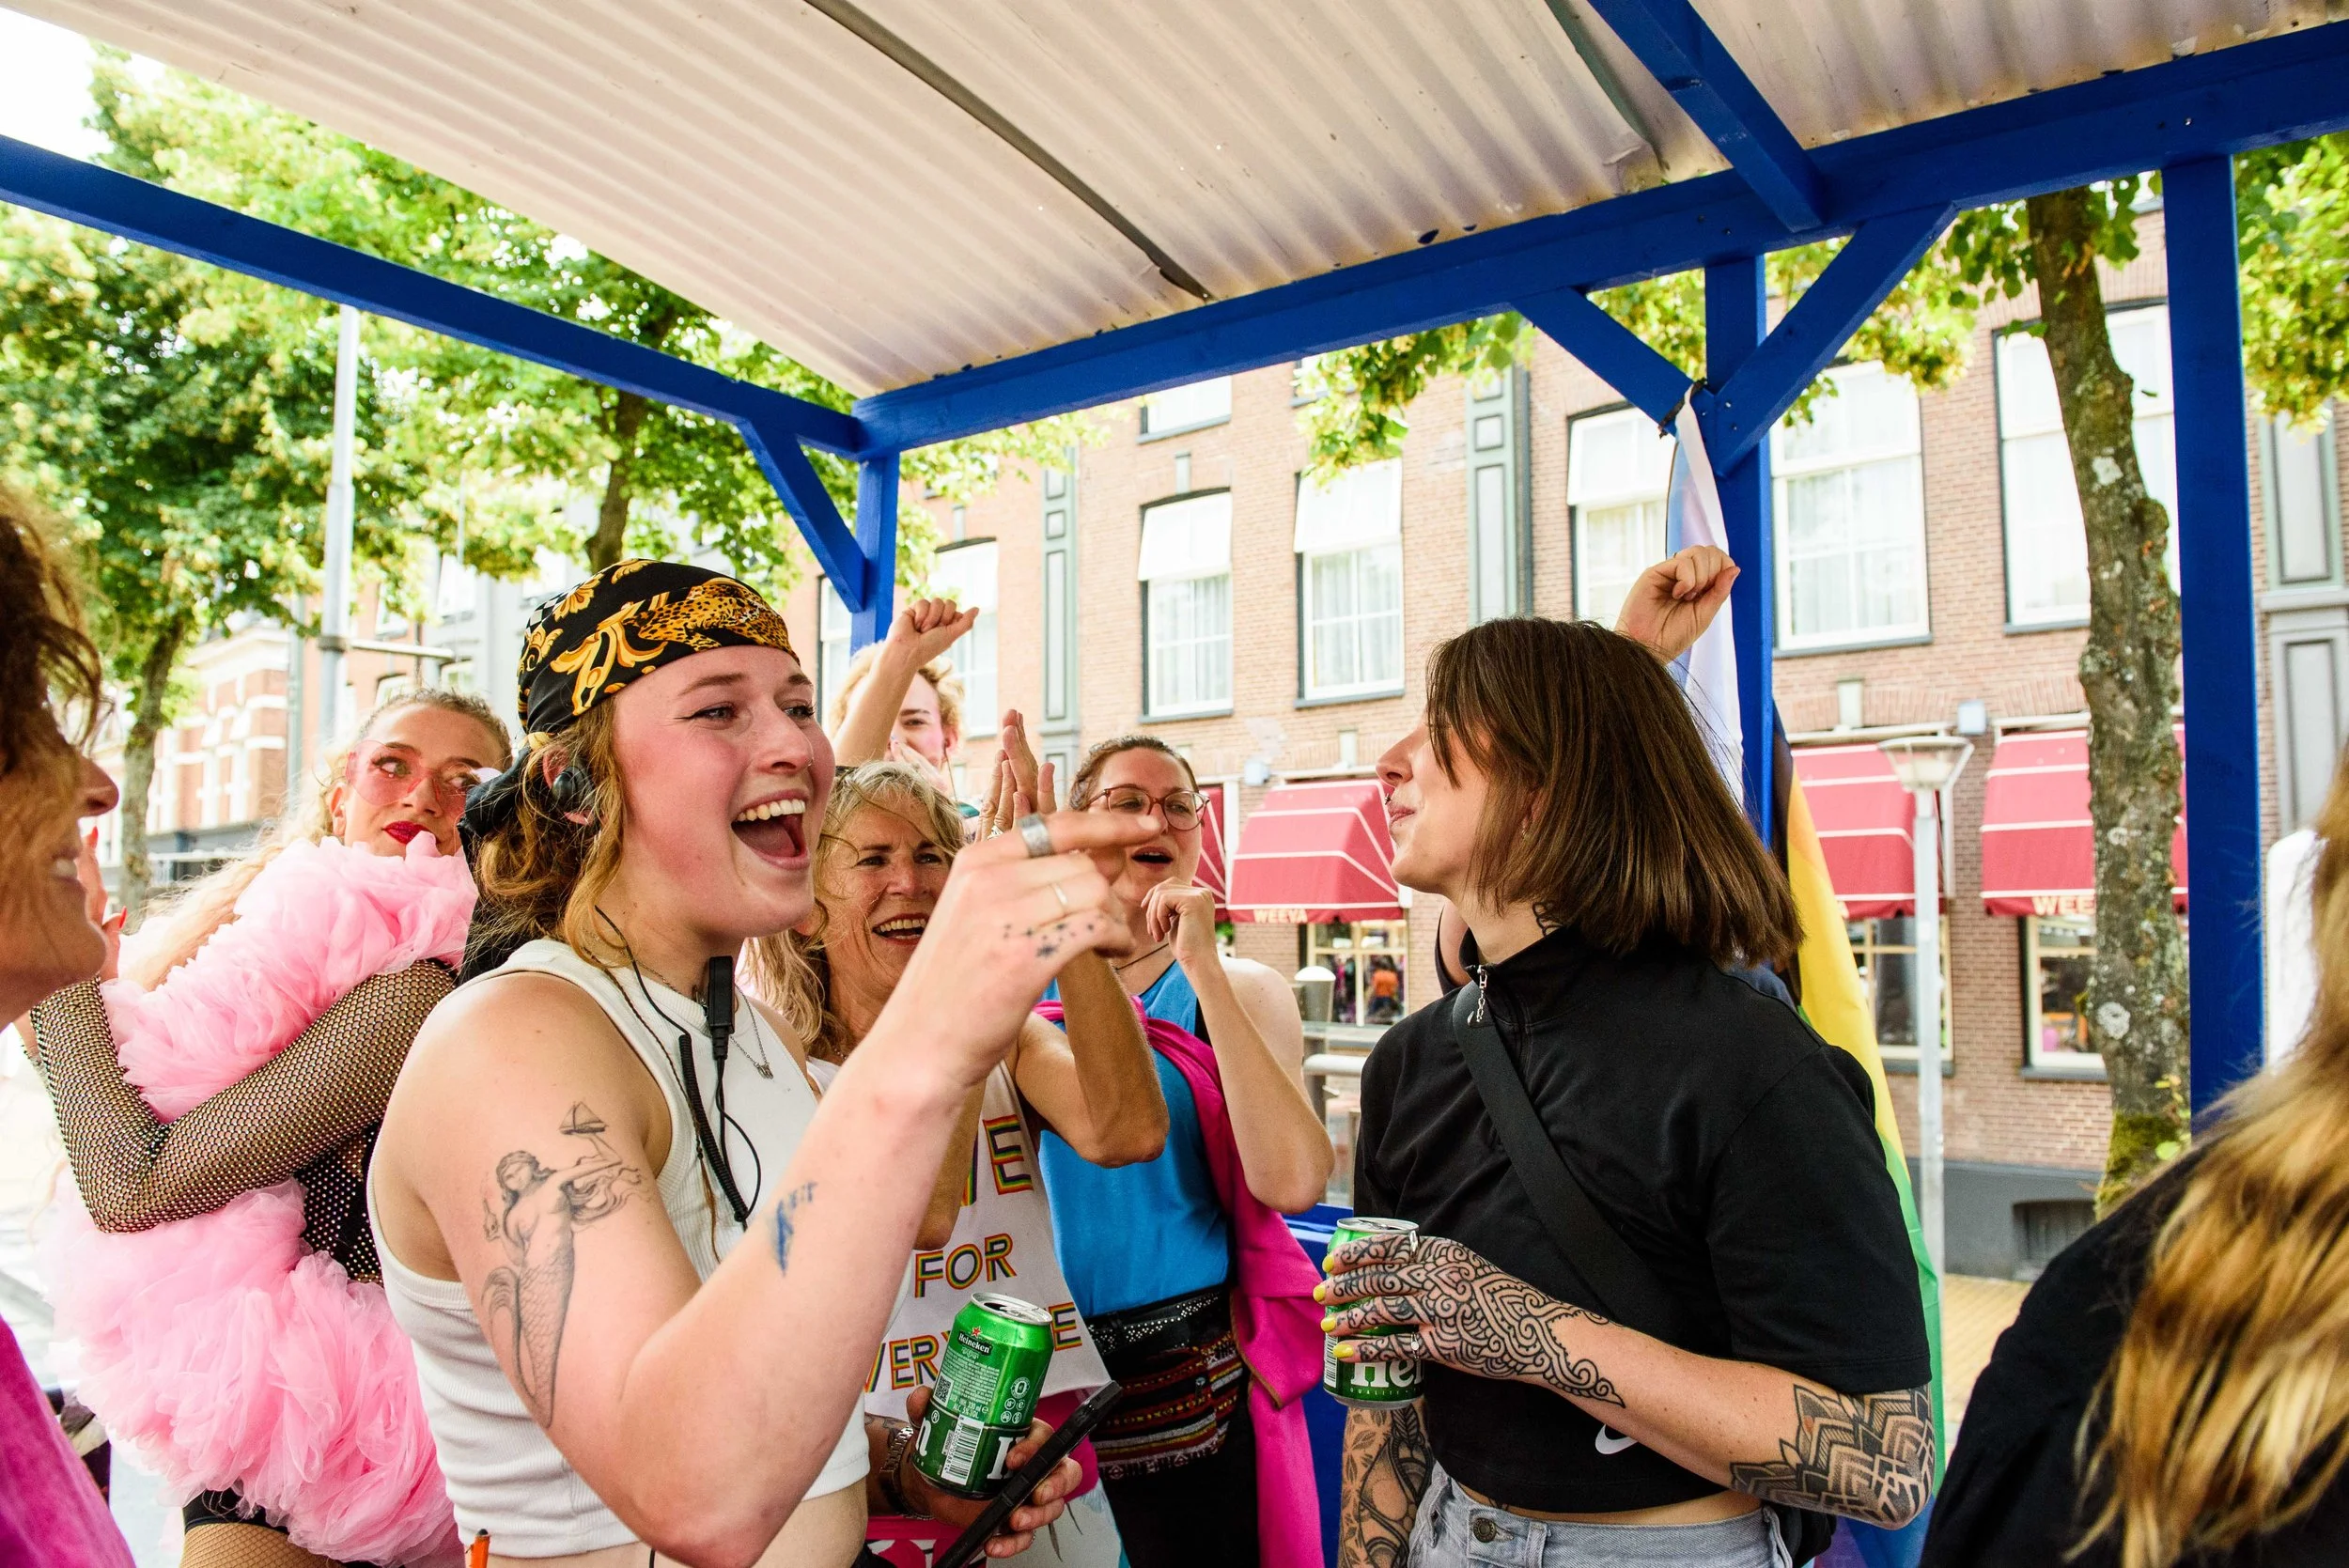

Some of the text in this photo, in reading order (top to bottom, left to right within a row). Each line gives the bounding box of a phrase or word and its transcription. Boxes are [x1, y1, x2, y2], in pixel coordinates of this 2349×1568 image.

[2031, 895, 2096, 915] WEE
[1253, 908, 1308, 924] WEEVA
[914, 1233, 1017, 1298] FOR
[958, 1332, 990, 1354] Heineken
